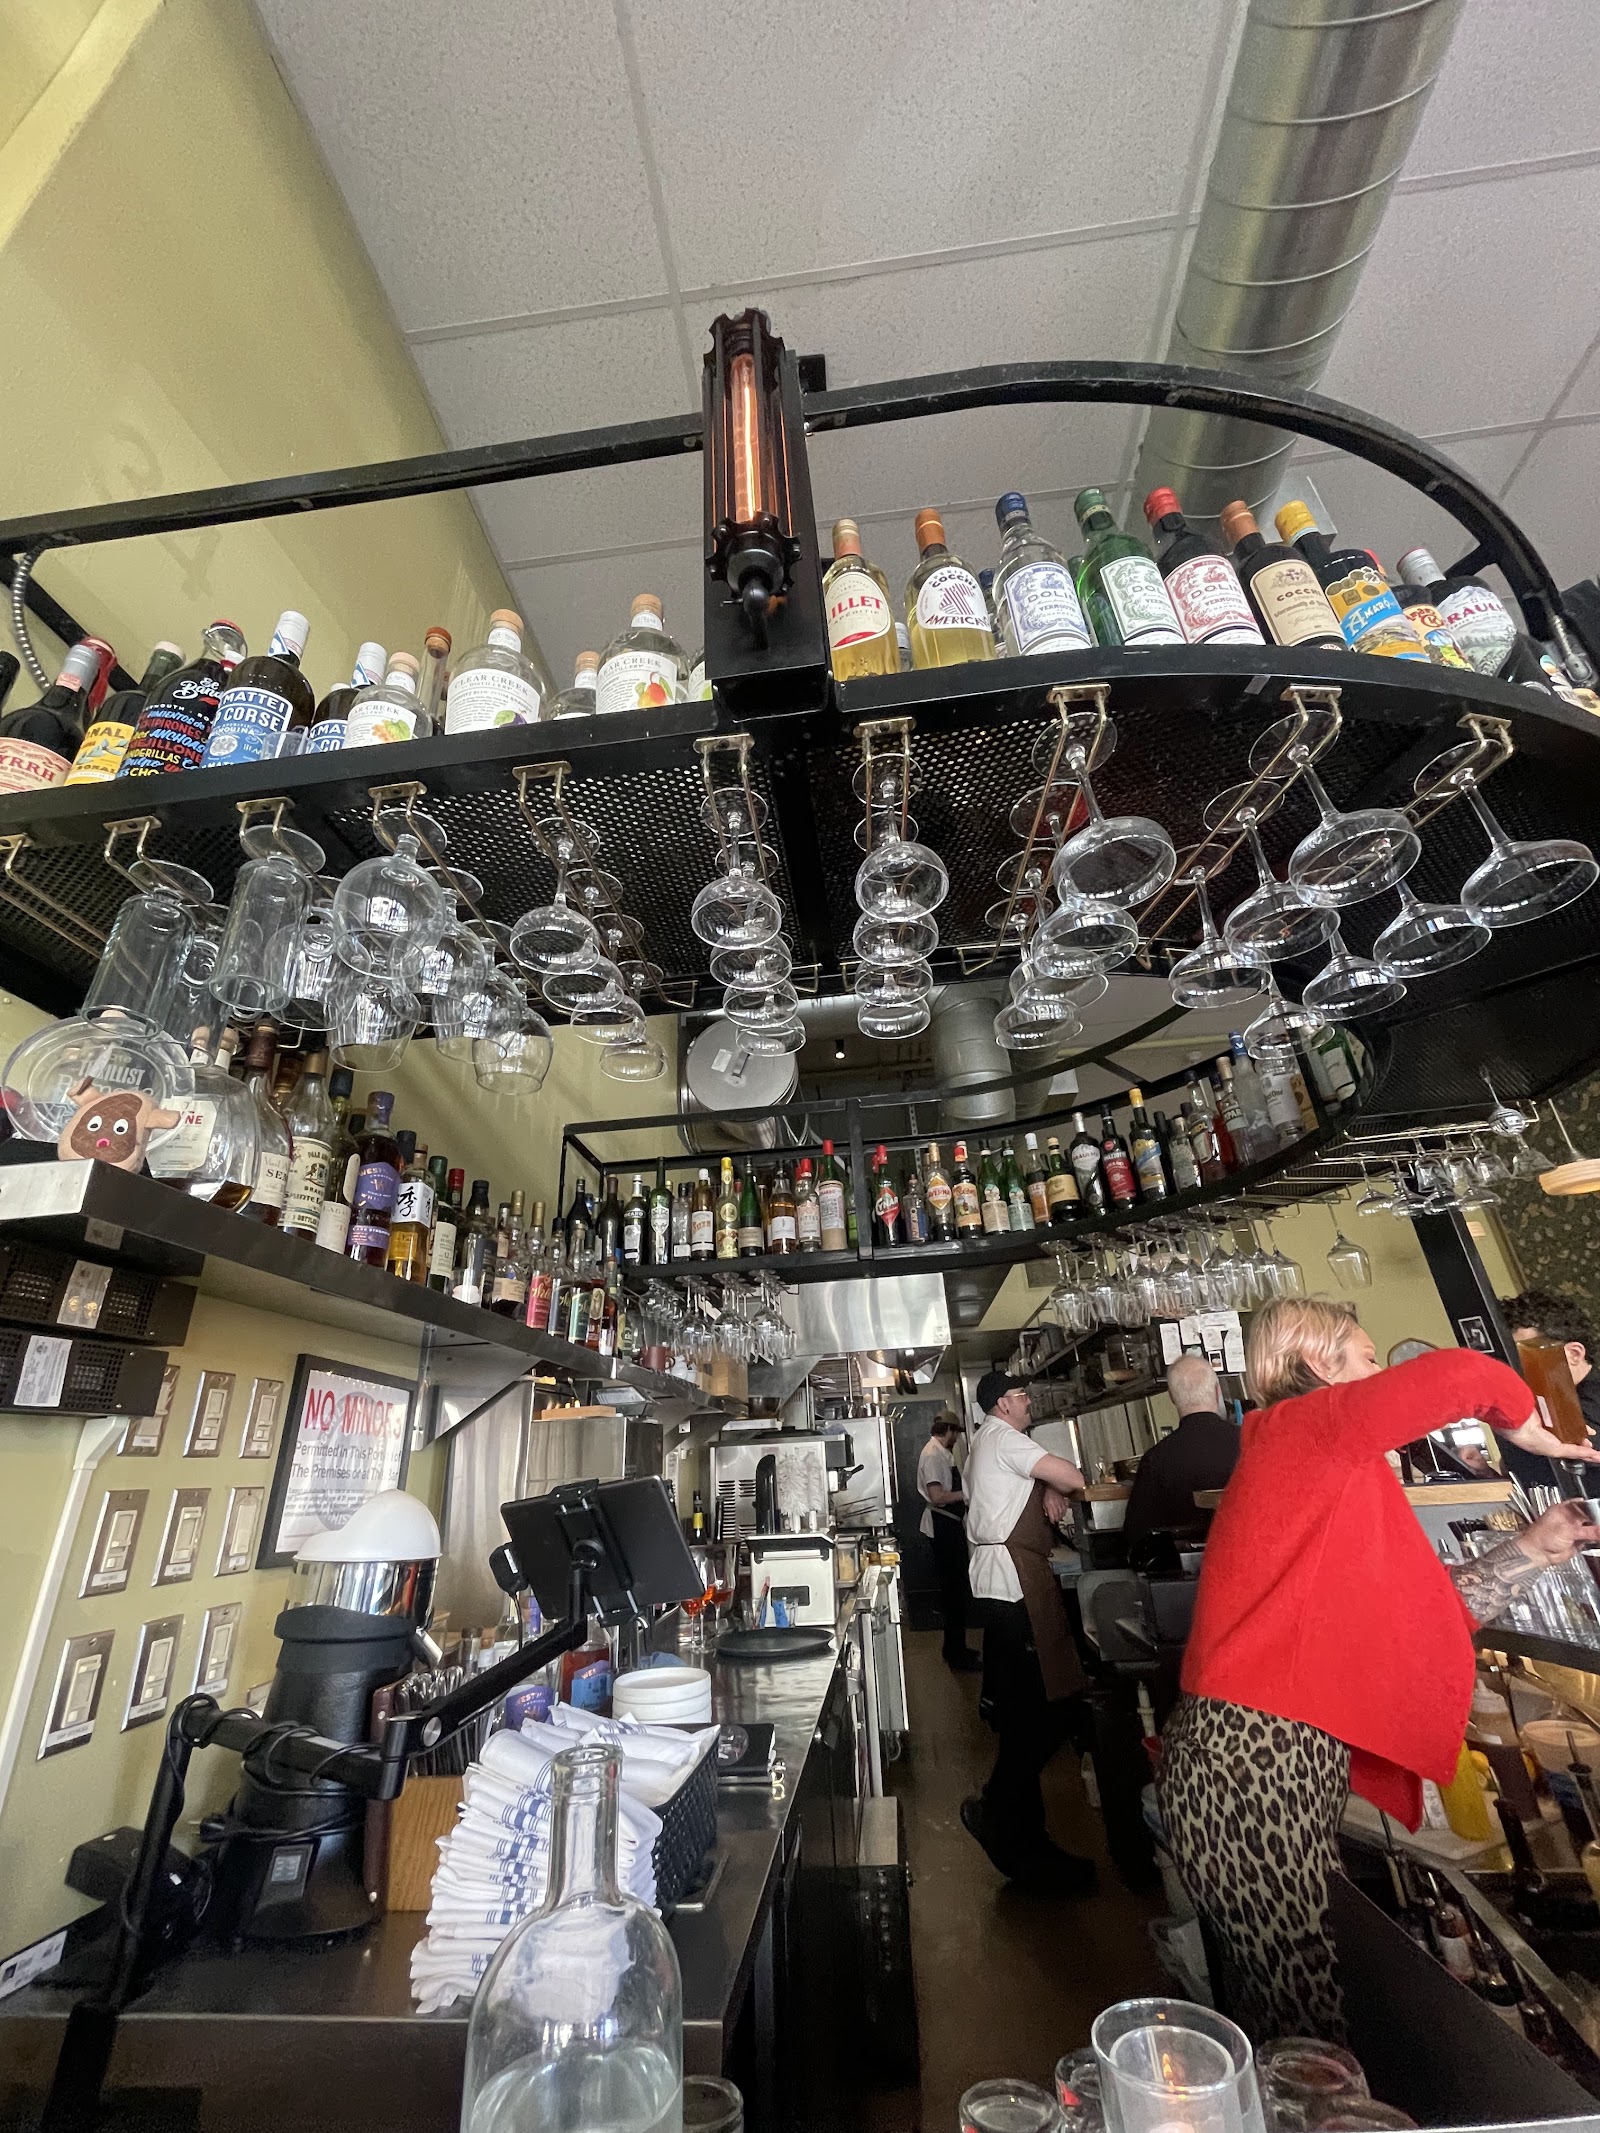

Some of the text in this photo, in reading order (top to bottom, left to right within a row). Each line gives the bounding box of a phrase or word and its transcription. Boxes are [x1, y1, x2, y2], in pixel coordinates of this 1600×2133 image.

[622, 657, 662, 669] CREEK
[454, 673, 530, 697] CLEAR CREEK
[223, 689, 286, 714] MATTEI
[222, 706, 282, 733] CORSE
[304, 1388, 336, 1431] NO
[296, 1441, 338, 1458] Permitted
[338, 1446, 348, 1458] in
[350, 1446, 367, 1460] This
[290, 1463, 310, 1478] The
[311, 1464, 350, 1480] Premises
[352, 1468, 362, 1480] or
